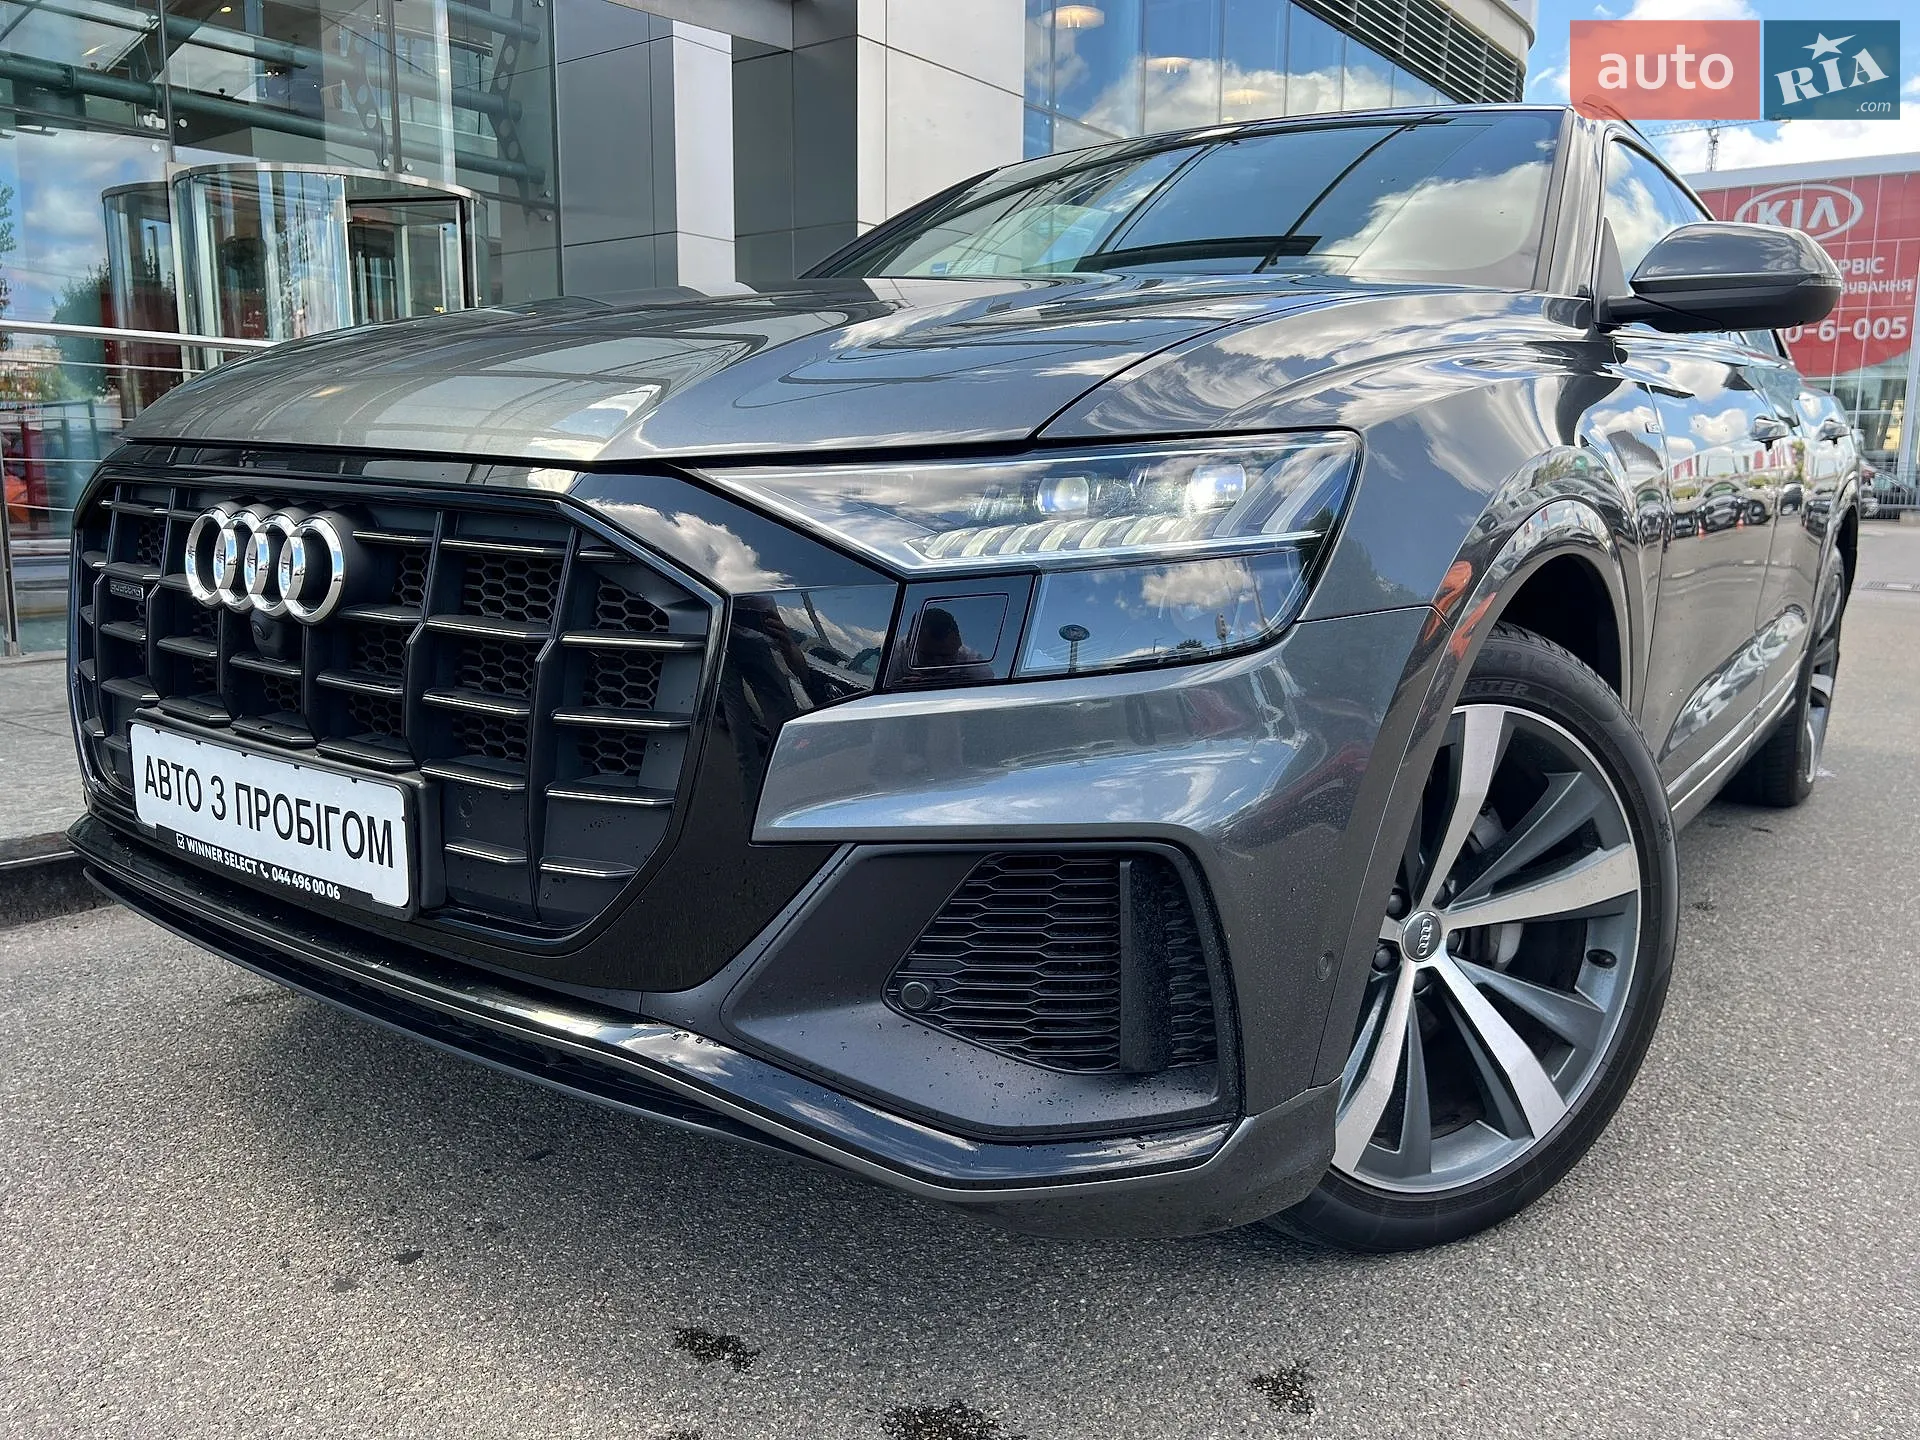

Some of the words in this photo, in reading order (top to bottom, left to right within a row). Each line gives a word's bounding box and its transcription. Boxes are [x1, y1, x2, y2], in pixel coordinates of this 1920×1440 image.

[1756, 195, 1840, 230] KIA
[1836, 256, 1885, 275] РВІС
[144, 755, 202, 813] АВТО
[210, 775, 227, 821] З
[234, 781, 394, 869] ПРОБІГОМ
[186, 837, 224, 864] WINNER
[224, 853, 257, 875] SELECT
[271, 866, 291, 886] 044
[291, 873, 312, 892] 496
[312, 880, 326, 896] 00
[326, 884, 341, 900] 06
